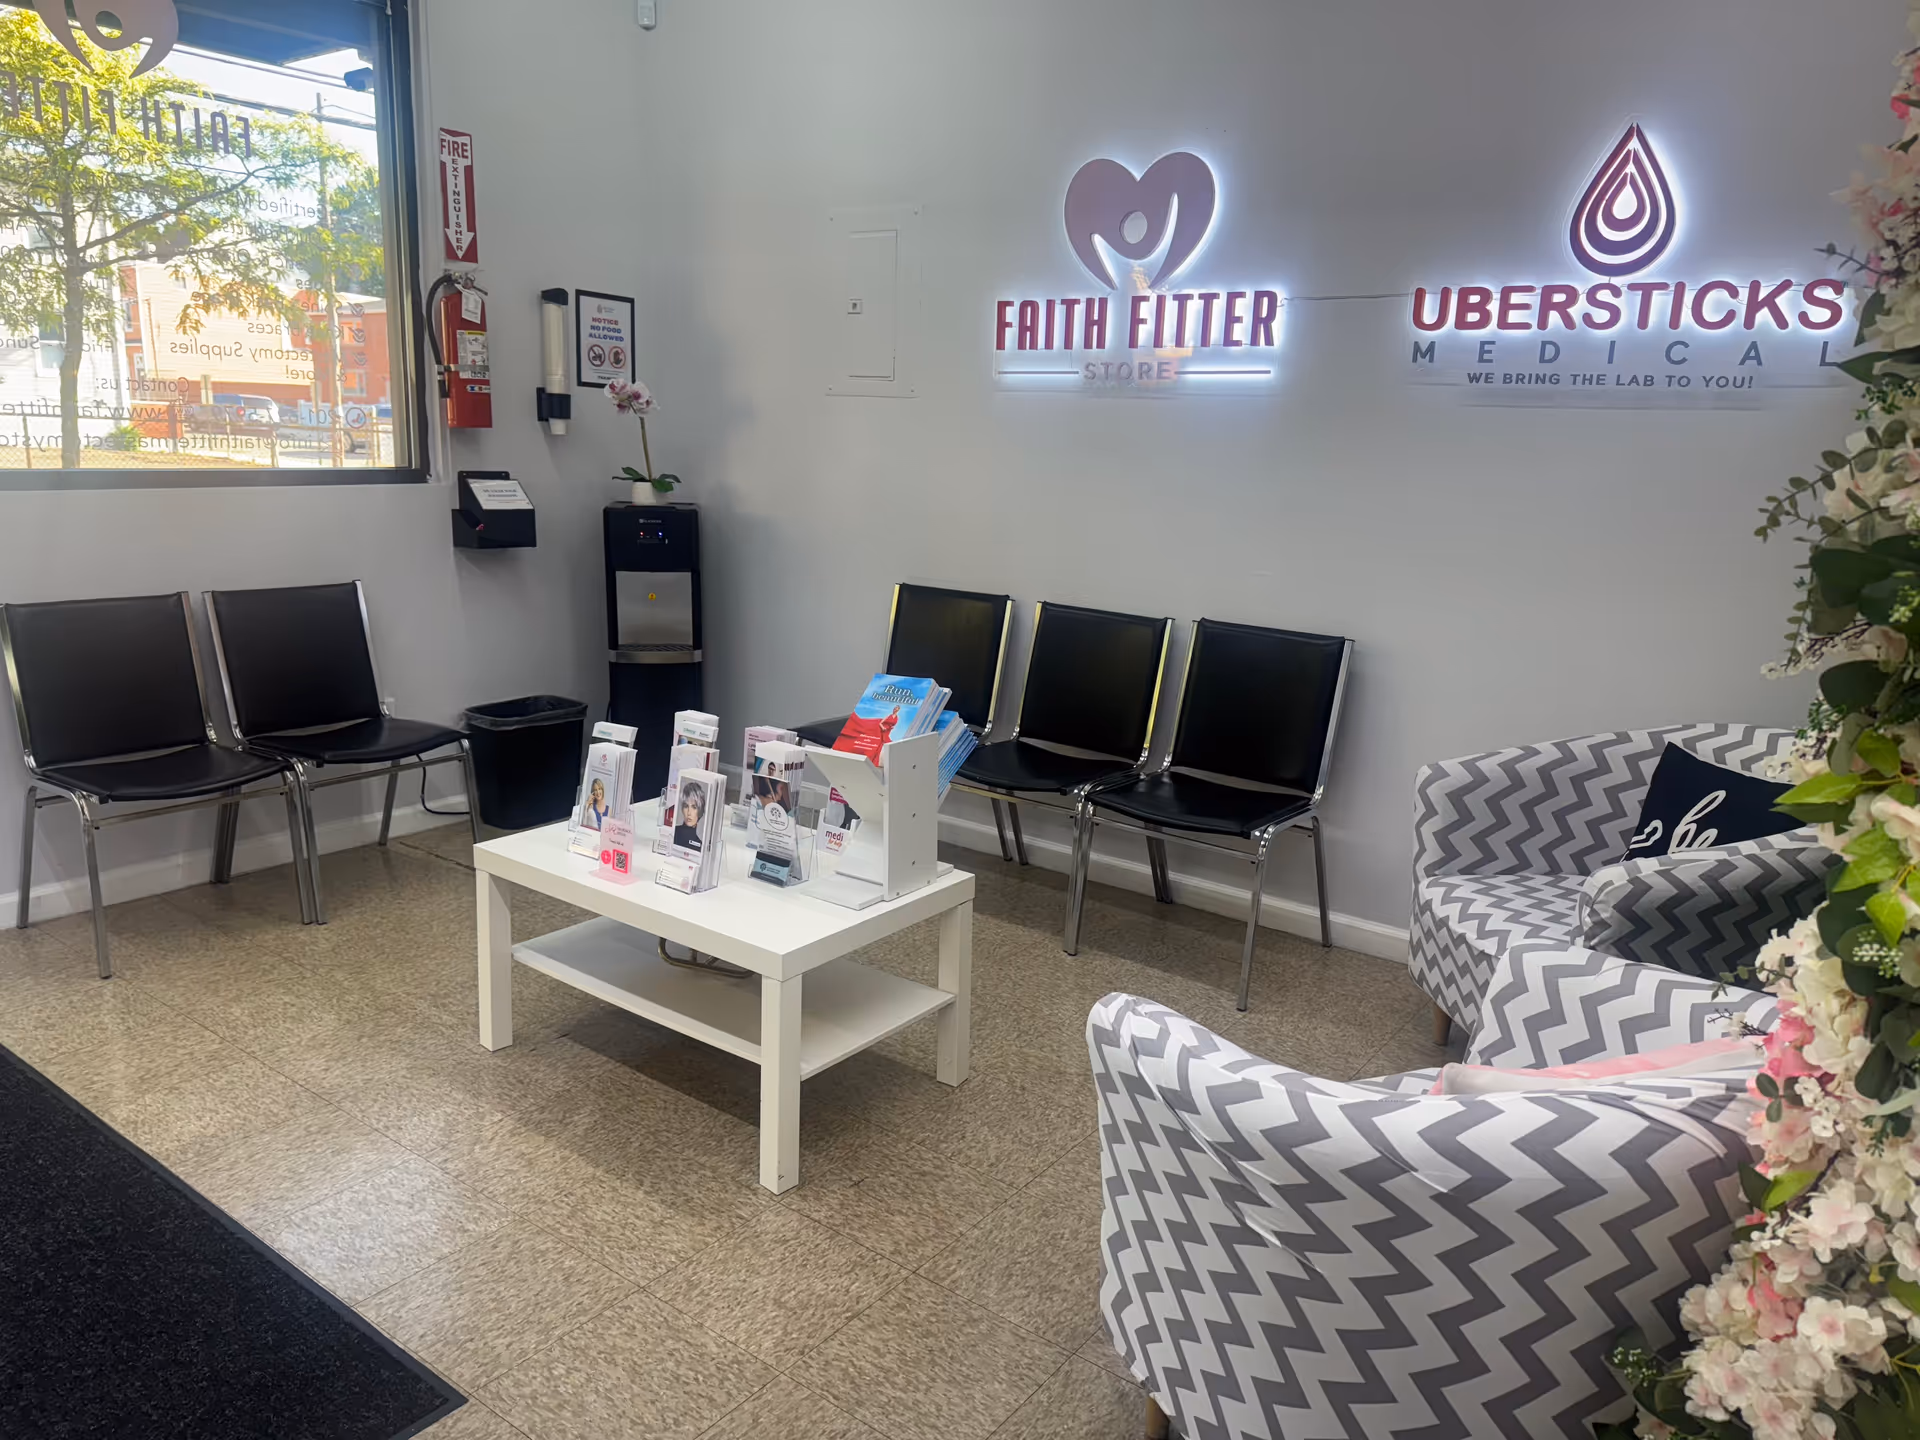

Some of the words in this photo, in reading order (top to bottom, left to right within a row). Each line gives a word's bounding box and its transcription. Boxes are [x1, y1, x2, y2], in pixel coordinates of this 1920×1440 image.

[440, 138, 469, 159] FIRE
[451, 158, 464, 252] EXTINGUISHER
[1411, 278, 1845, 332] UBERSTICKS
[591, 317, 619, 326] NOTICE
[996, 297, 1108, 351] FAITH
[1128, 290, 1279, 349] FITTER
[588, 332, 625, 342] ALLOWED
[601, 326, 622, 334] FOOD
[1411, 340, 1839, 367] MEDICAL
[1083, 361, 1172, 381] STORE
[1467, 372, 1495, 385] WE
[1502, 372, 1561, 386] BRING
[1570, 373, 1607, 386] THE
[1615, 373, 1656, 387] LAB
[1666, 374, 1692, 388] TO
[1702, 375, 1754, 389] YOU!
[872, 692, 920, 706] beautiful
[825, 830, 844, 842] medi
